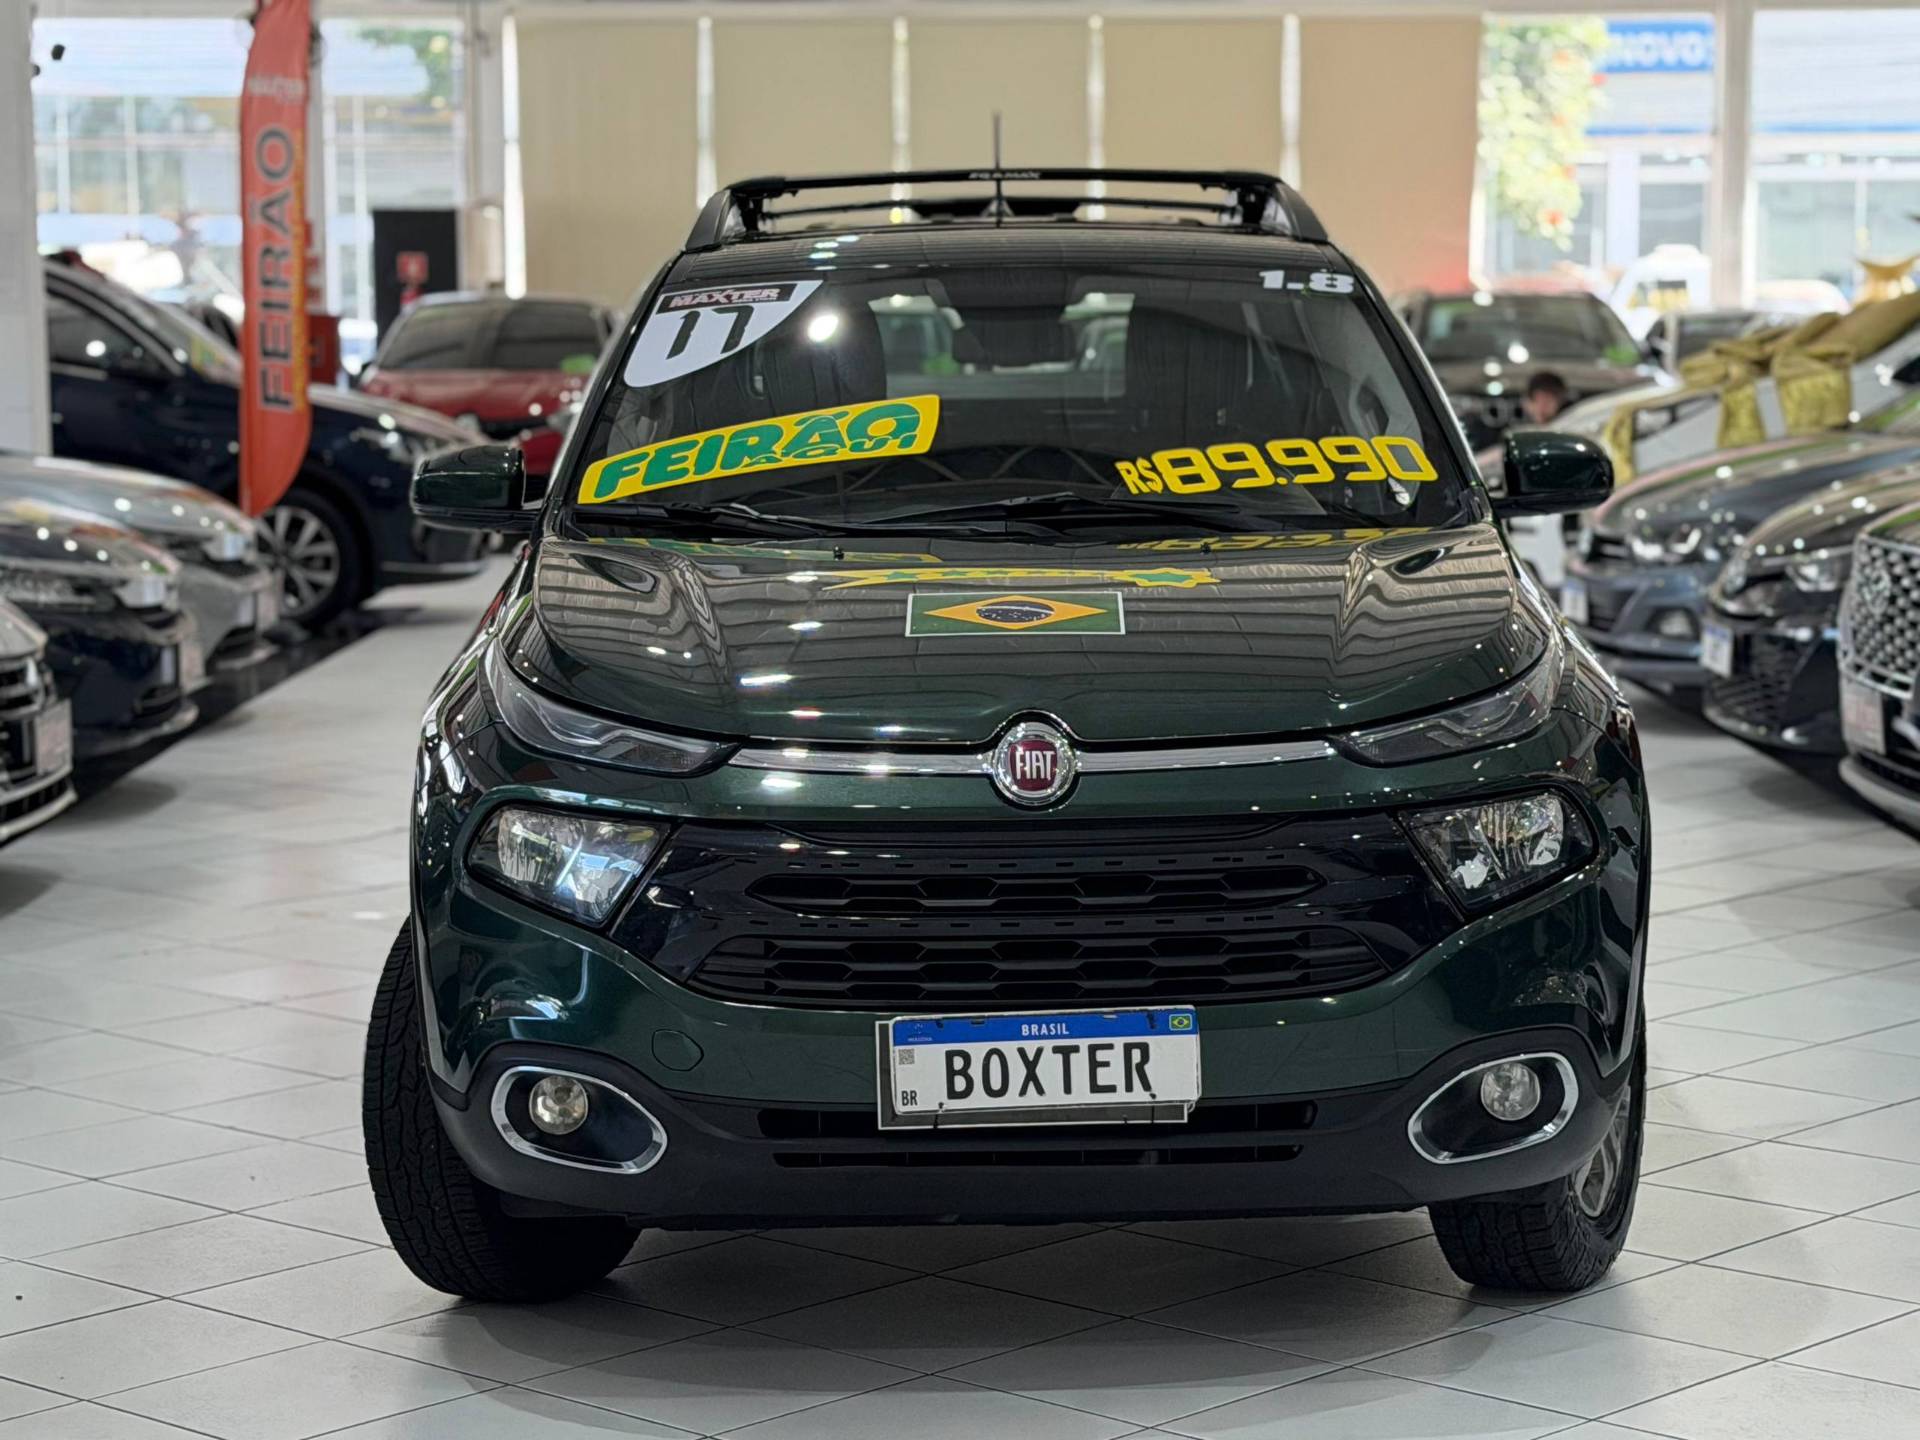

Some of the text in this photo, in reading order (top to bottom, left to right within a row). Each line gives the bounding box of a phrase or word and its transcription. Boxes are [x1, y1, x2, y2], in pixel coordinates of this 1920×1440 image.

[251, 124, 294, 410] FEIRÃO
[668, 288, 780, 308] MAXTER
[665, 305, 755, 360] 17
[593, 403, 921, 499] FEIRÃO
[1016, 750, 1055, 780] FIAT
[1021, 1023, 1069, 1036] BRASIL
[945, 1042, 1152, 1100] BOXTER
[901, 1090, 918, 1106] BR
